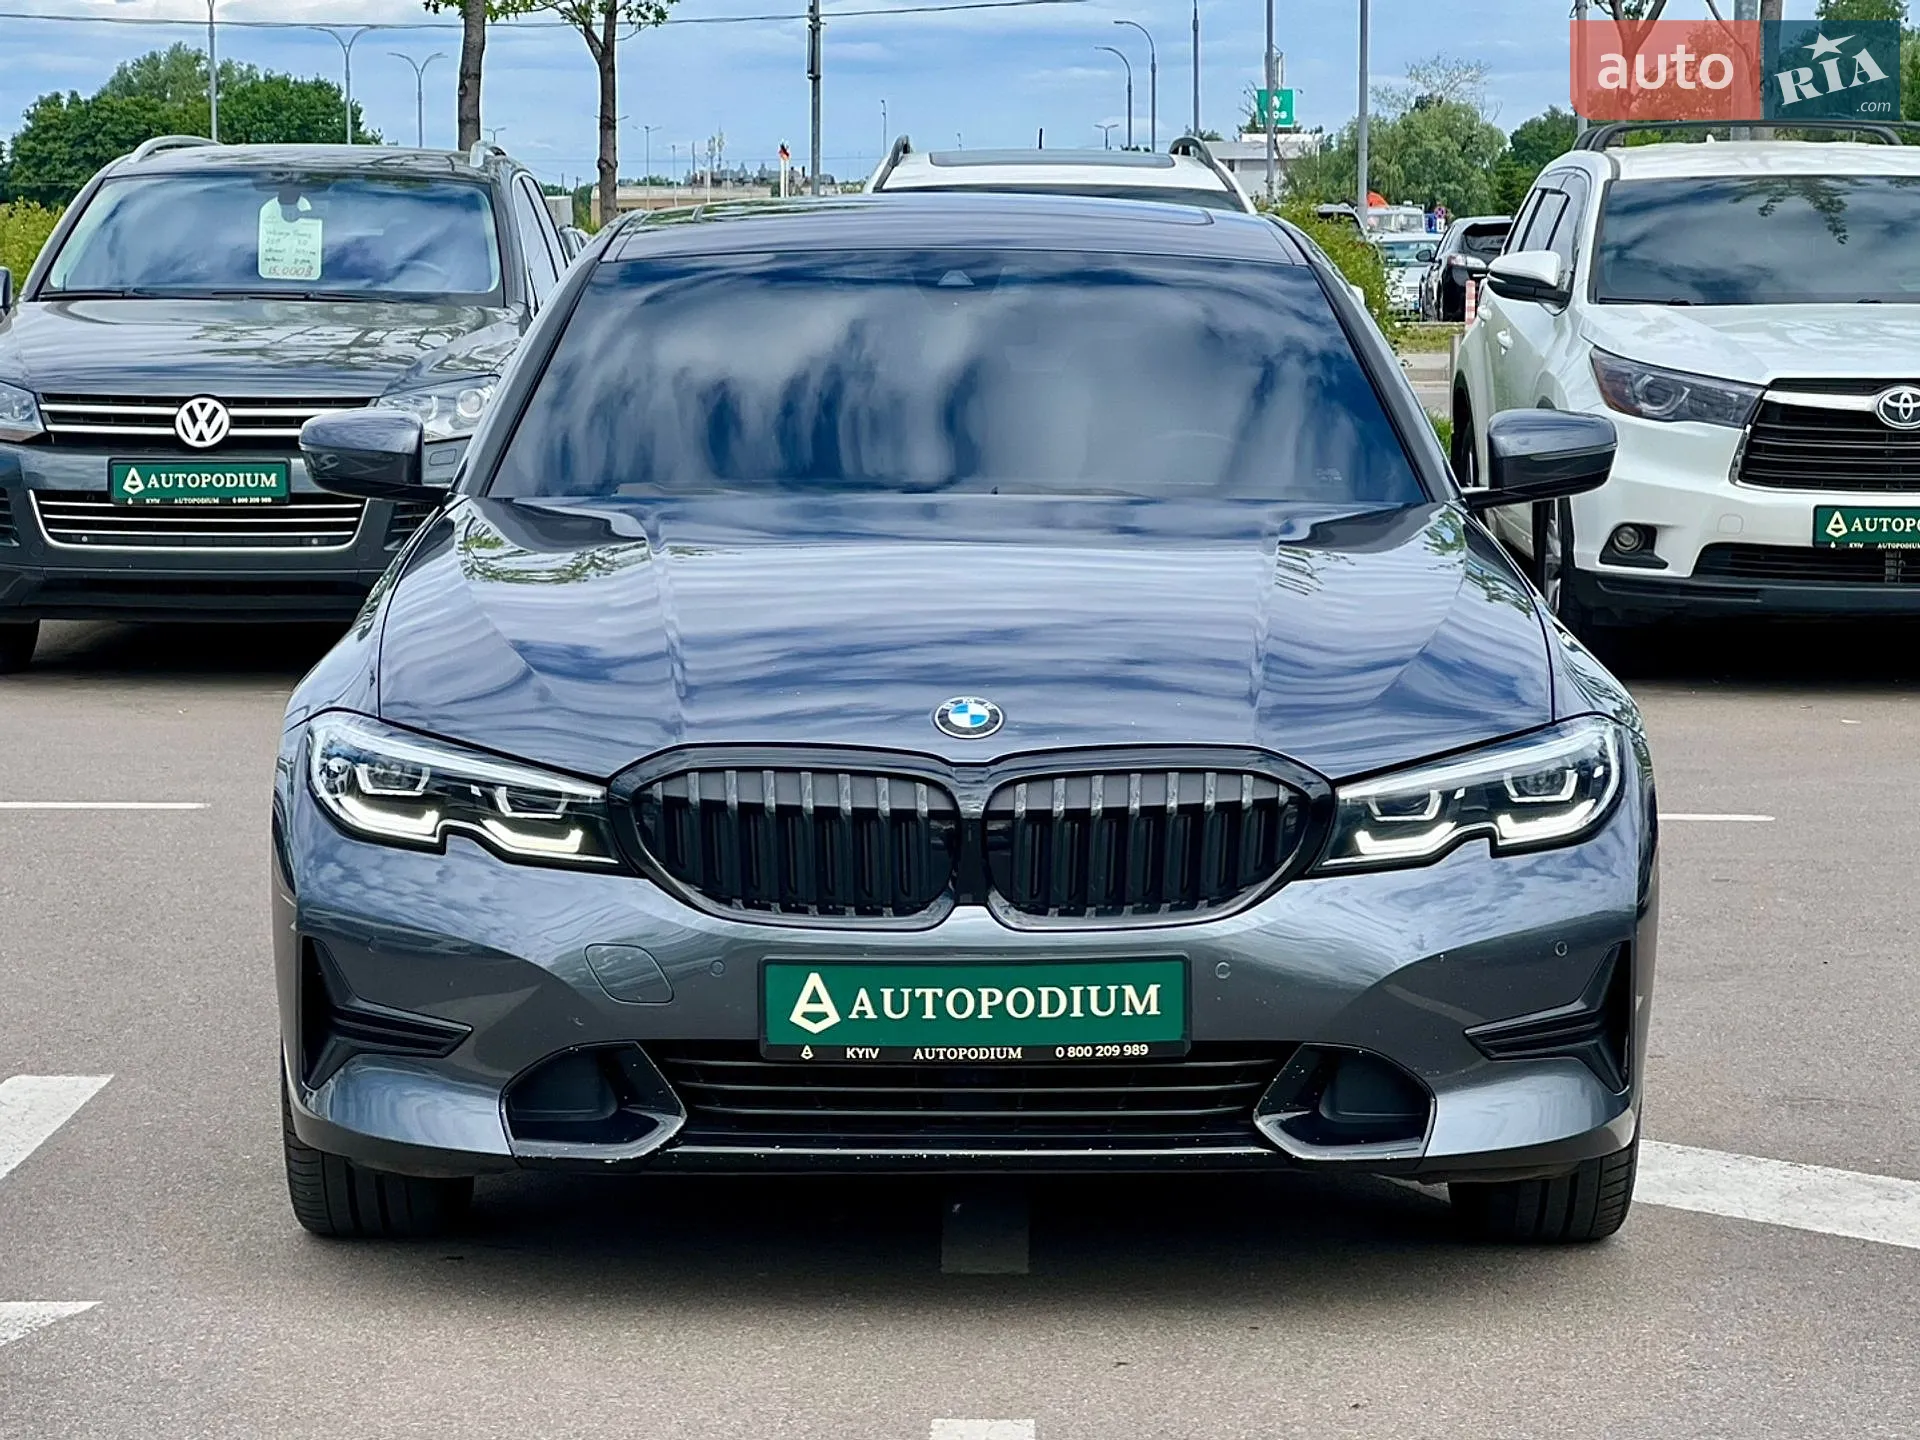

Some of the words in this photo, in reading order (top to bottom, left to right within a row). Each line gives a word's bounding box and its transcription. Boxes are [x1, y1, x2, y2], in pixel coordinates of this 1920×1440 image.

[147, 473, 277, 489] AUTOPODIUM
[848, 984, 1161, 1020] AUTOPODIUM
[845, 1047, 880, 1059] KYIV
[912, 1046, 1022, 1060] AUTOPODIUM
[1055, 1046, 1064, 1059] 0
[1066, 1045, 1095, 1058] 800
[1097, 1044, 1120, 1058] 209
[1122, 1043, 1149, 1057] 989
